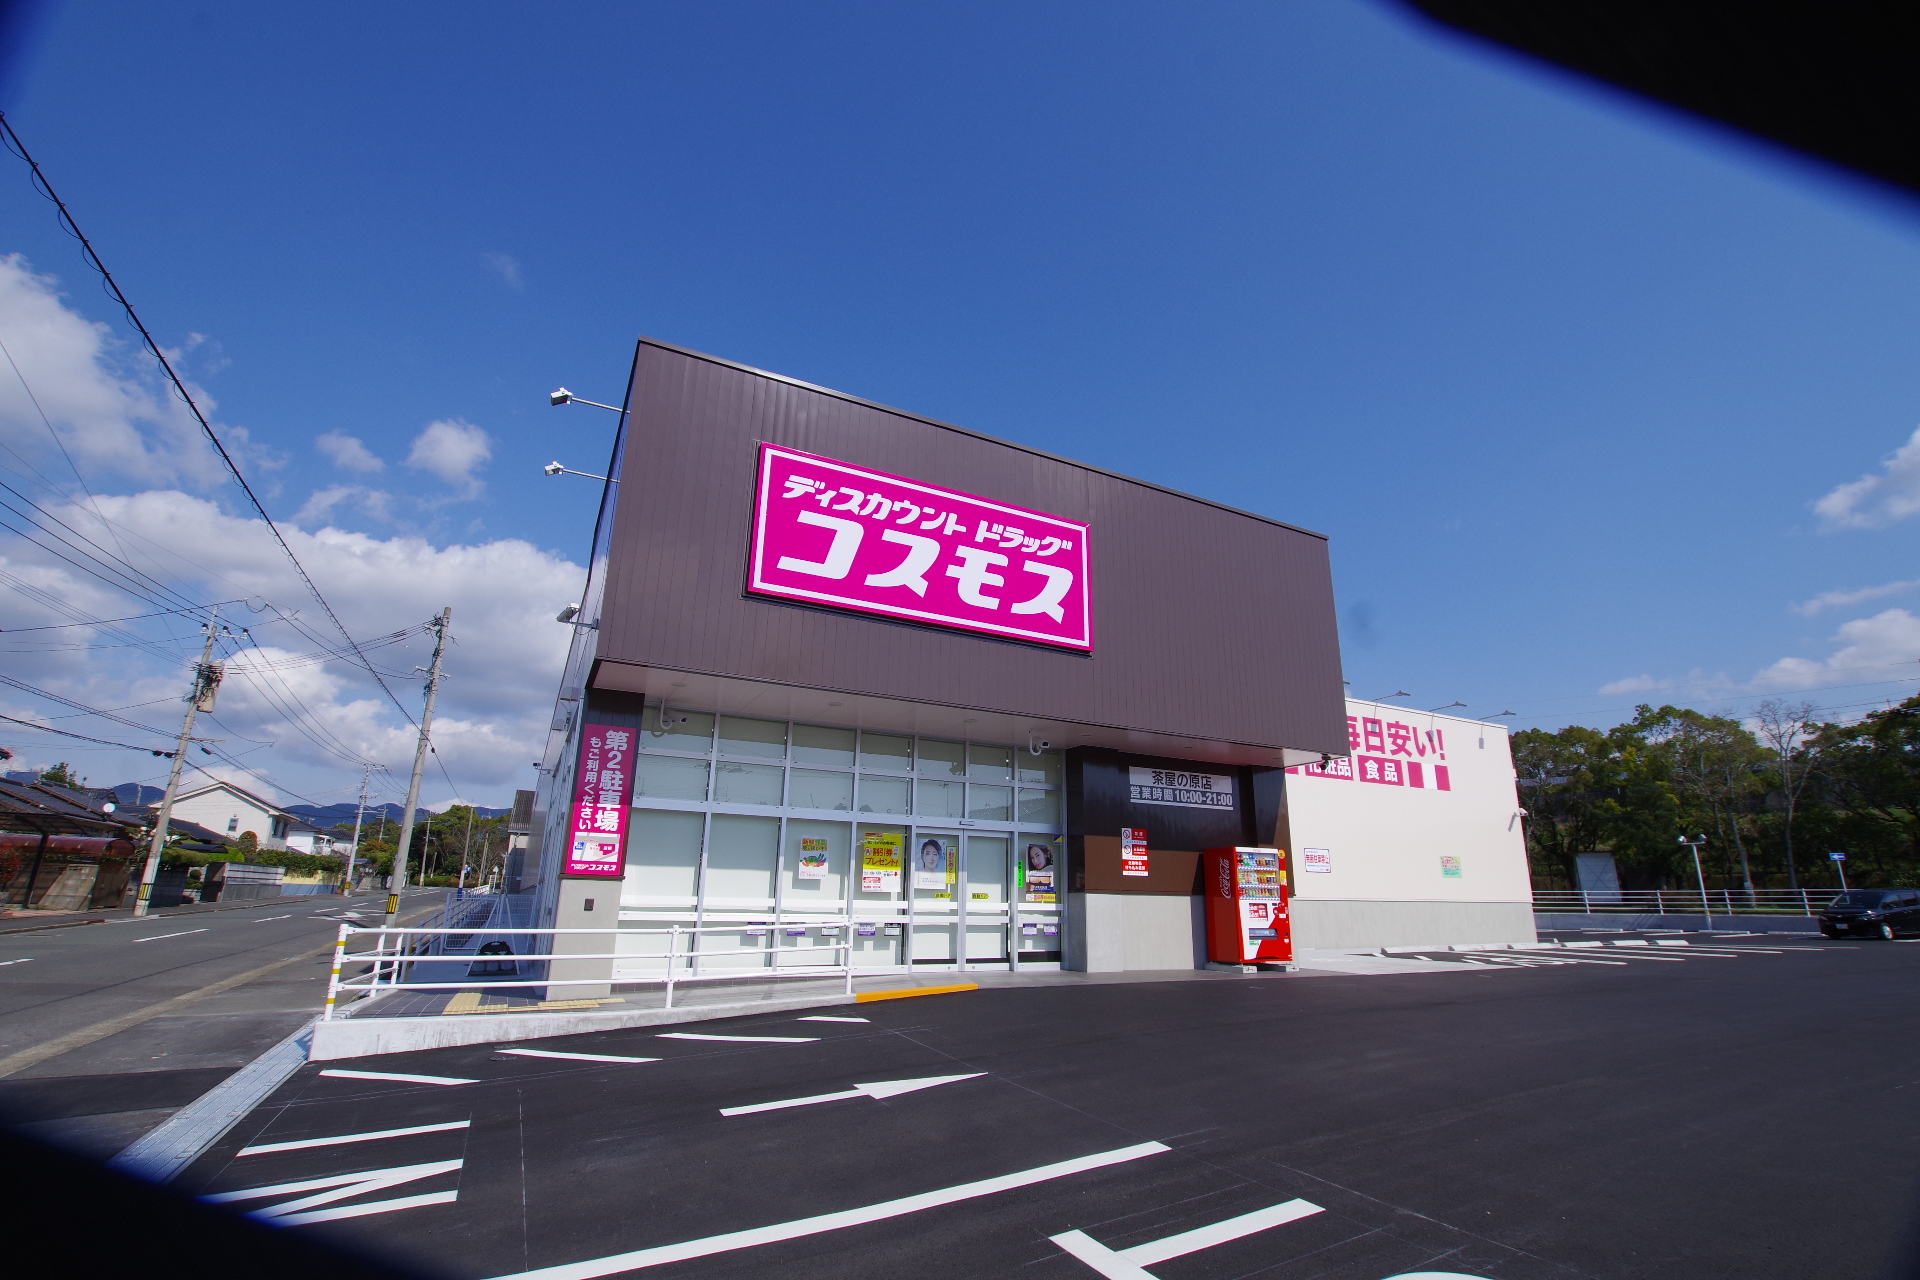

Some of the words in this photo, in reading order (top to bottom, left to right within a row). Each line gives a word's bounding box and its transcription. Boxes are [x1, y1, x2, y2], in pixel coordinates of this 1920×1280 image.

[782, 475, 967, 536] ディスカウント
[975, 519, 1073, 557] ドラッグ
[776, 509, 1074, 625] コスモス
[578, 736, 602, 830] もご利用ください
[594, 730, 630, 831] 第2駐車場
[1152, 769, 1213, 791] 茶屋の原店
[1365, 759, 1399, 783] 食品
[588, 864, 617, 872] コスモス
